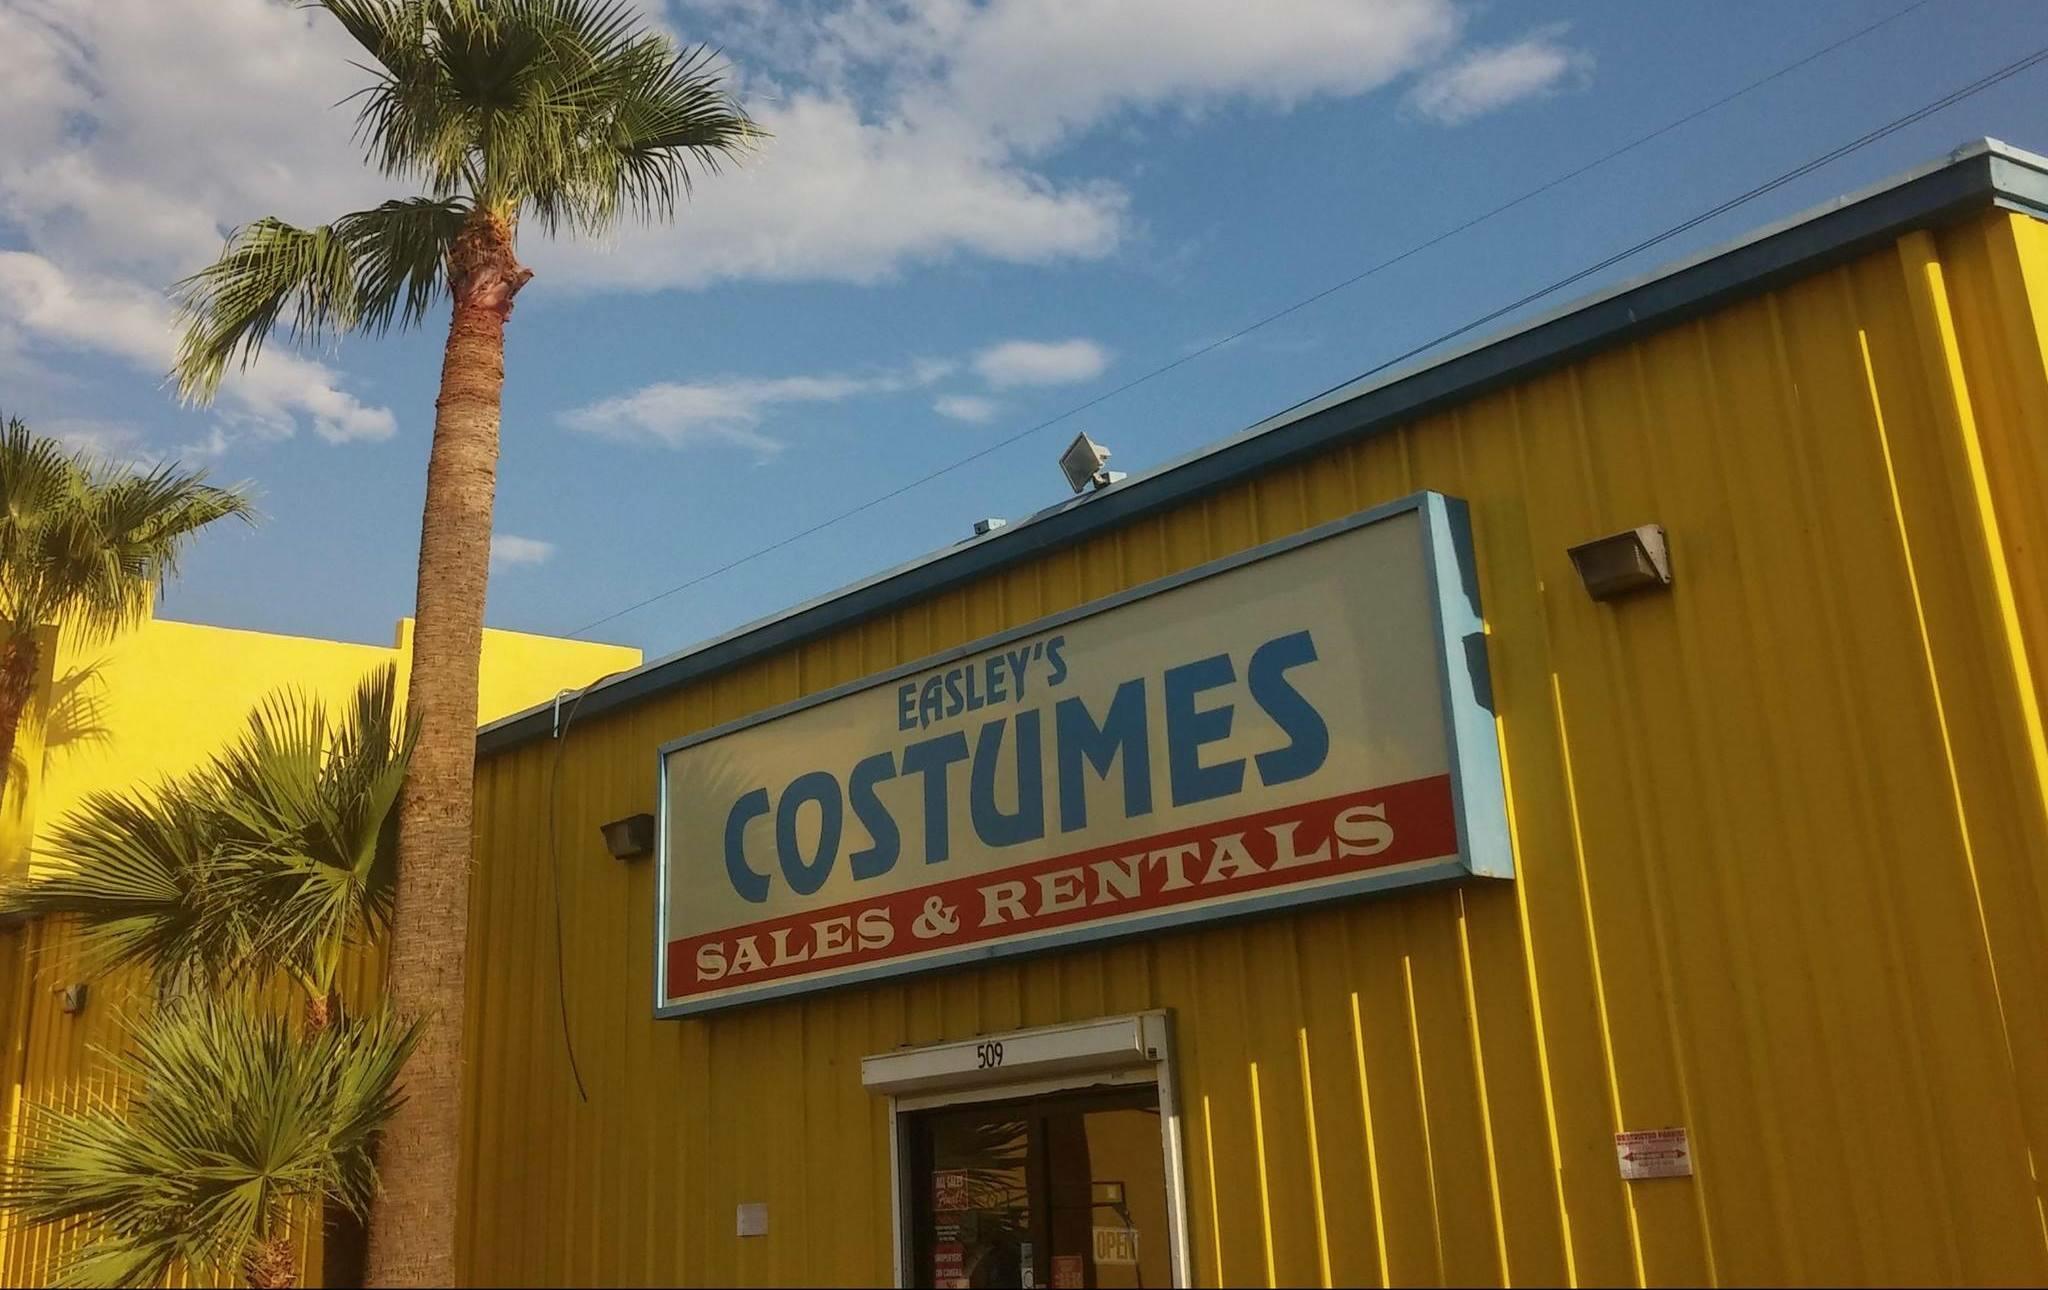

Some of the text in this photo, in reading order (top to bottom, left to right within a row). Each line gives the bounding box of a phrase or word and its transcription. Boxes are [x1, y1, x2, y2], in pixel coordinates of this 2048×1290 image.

[898, 635, 1068, 732] EASLEY'S
[724, 629, 1330, 904] COSTUMES
[695, 802, 1395, 983] SALES & RENTALS
[977, 1042, 1003, 1069] 509
[1097, 1231, 1137, 1260] OPEN
